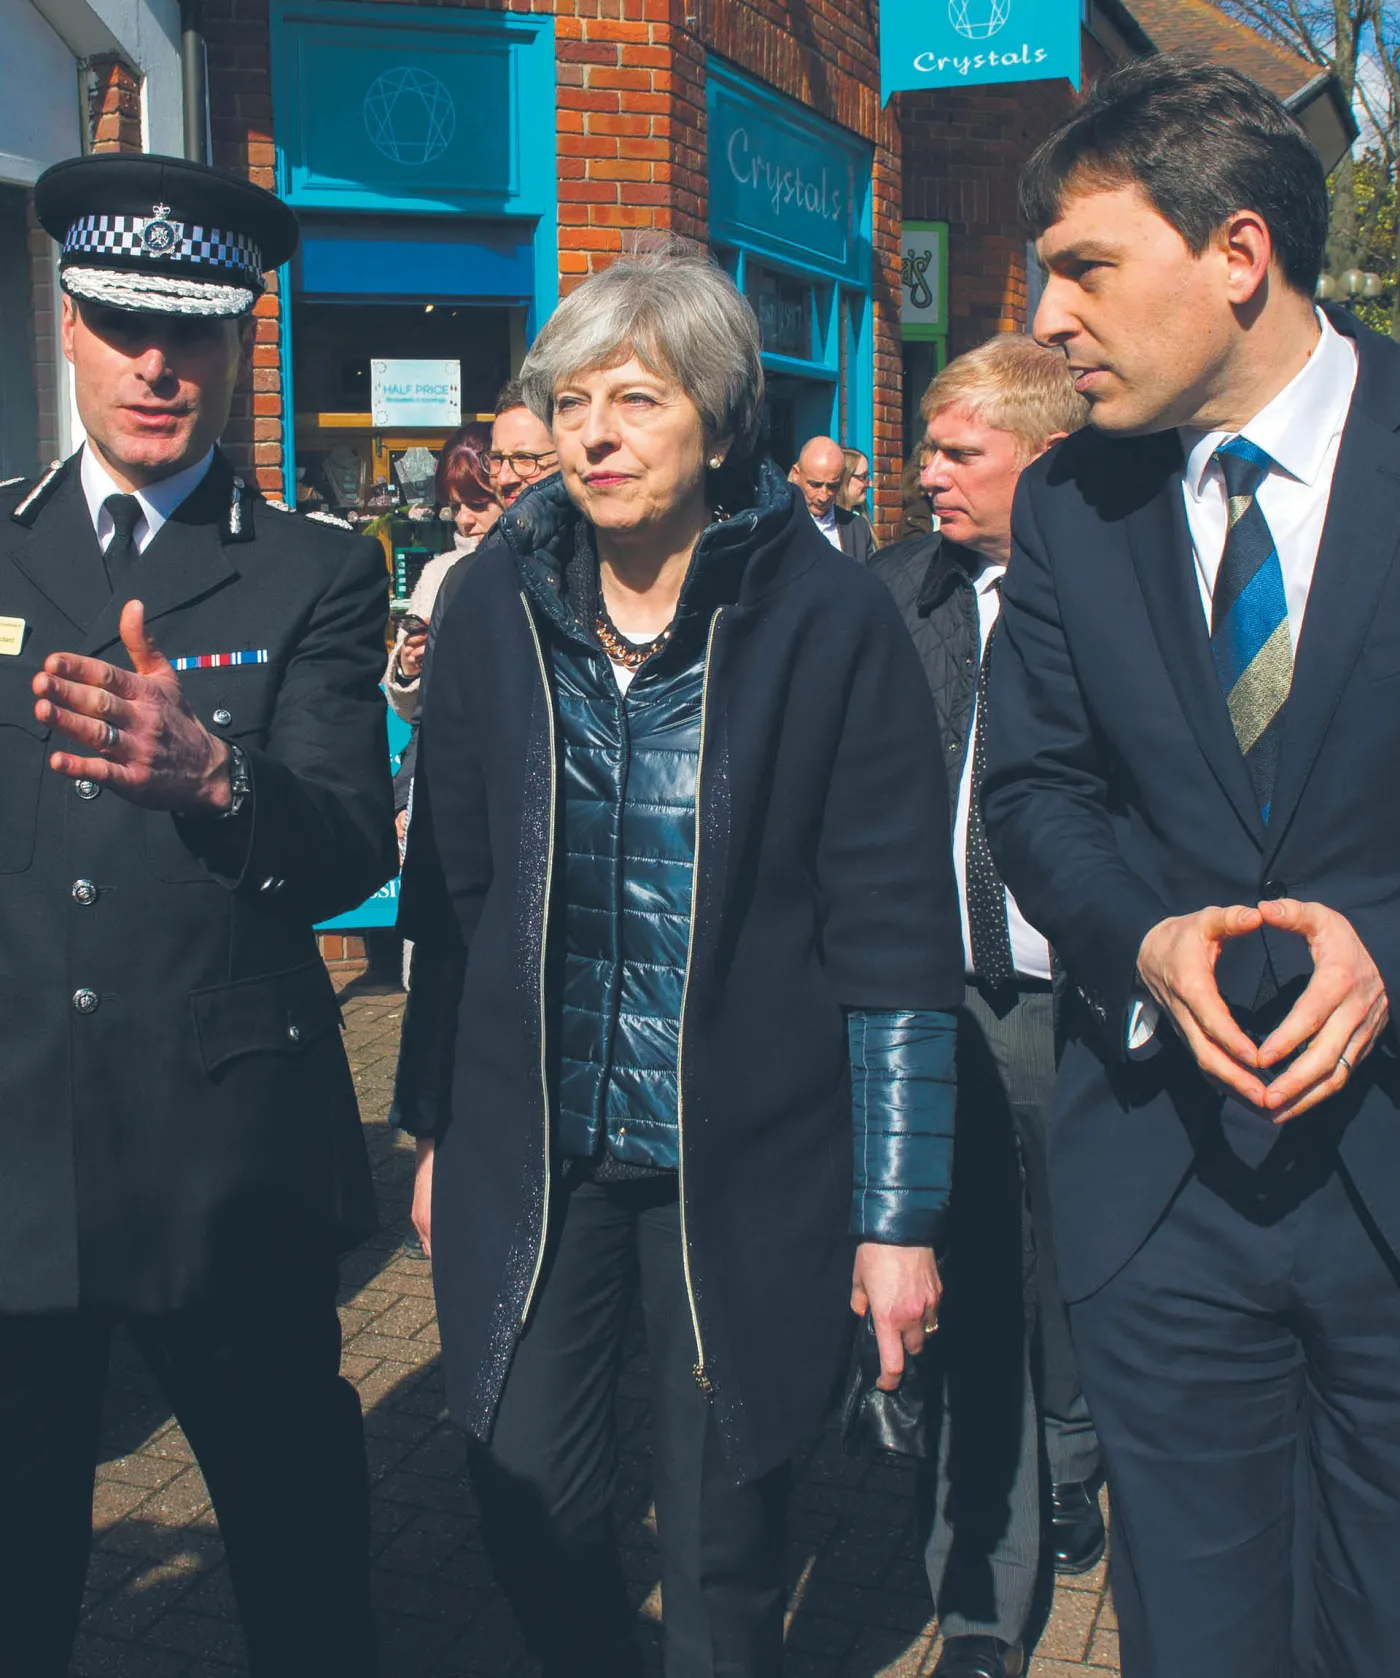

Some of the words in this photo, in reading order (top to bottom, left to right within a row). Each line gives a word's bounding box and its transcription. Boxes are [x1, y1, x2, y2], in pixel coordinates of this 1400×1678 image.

[913, 43, 1048, 75] Crystals
[727, 127, 841, 221] Crystals
[383, 384, 412, 396] HALF
[415, 384, 450, 396] PRICE
